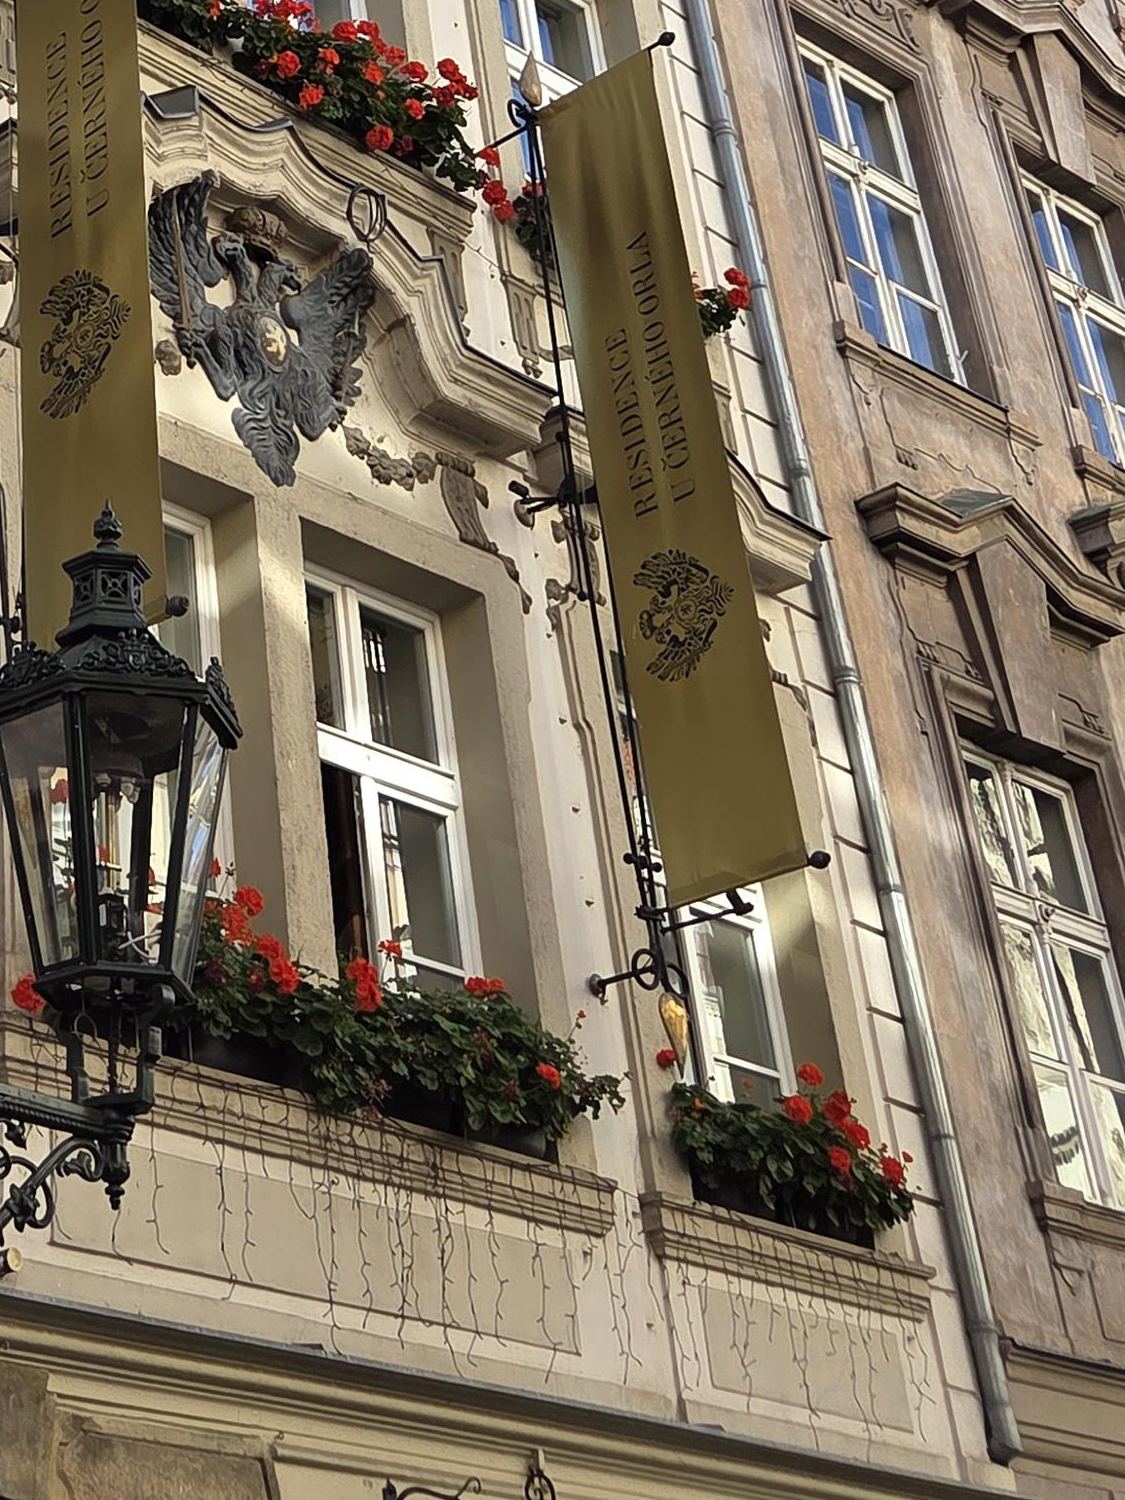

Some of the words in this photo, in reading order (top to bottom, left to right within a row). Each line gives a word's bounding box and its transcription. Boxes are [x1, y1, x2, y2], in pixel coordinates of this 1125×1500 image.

[45, 31, 73, 239] RESIDENCE
[77, 19, 109, 184] ČERNÉHO
[86, 188, 111, 218] U
[626, 230, 660, 316] ORLA
[604, 328, 659, 518] RESIDENCE
[642, 321, 691, 472] ČERNÉHO
[669, 477, 697, 503] U
